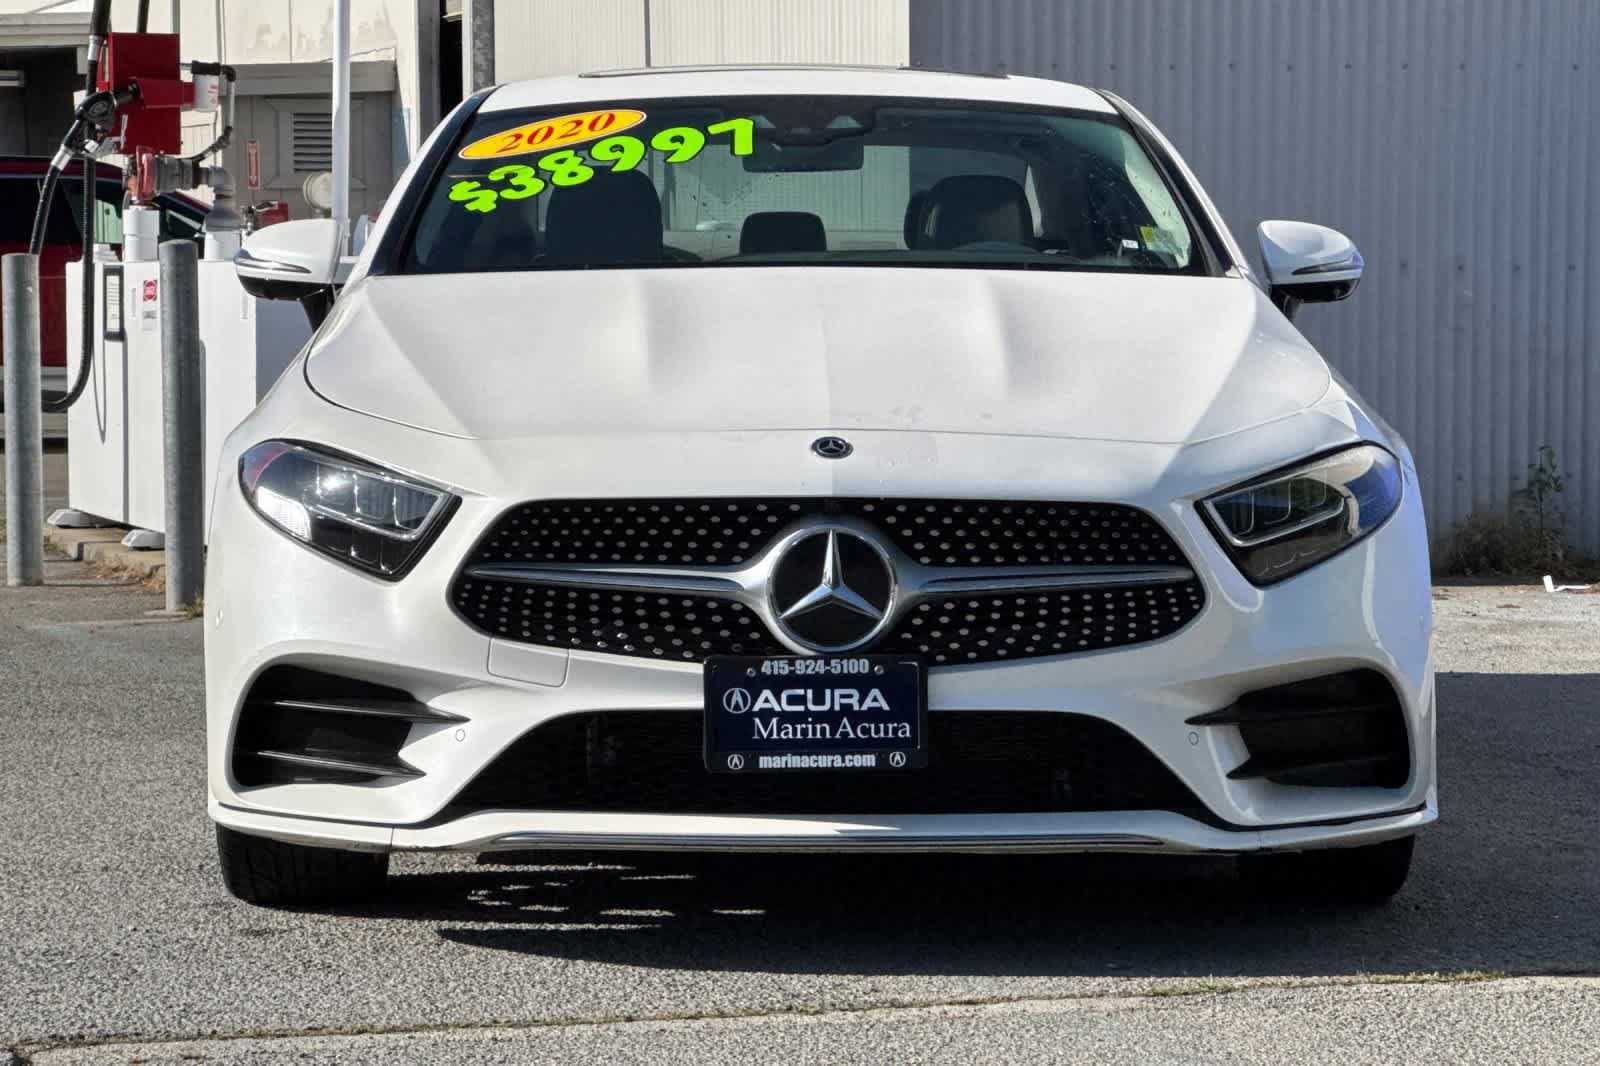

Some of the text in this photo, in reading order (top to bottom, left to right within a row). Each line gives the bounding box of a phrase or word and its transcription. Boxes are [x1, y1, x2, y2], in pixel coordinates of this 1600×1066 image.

[496, 112, 616, 154] 2020
[449, 117, 755, 213] $38997
[761, 659, 869, 674] 415-924-5100
[752, 688, 890, 711] ACURA
[752, 717, 911, 739] Marin Acura
[759, 753, 875, 768] marinacura.com
